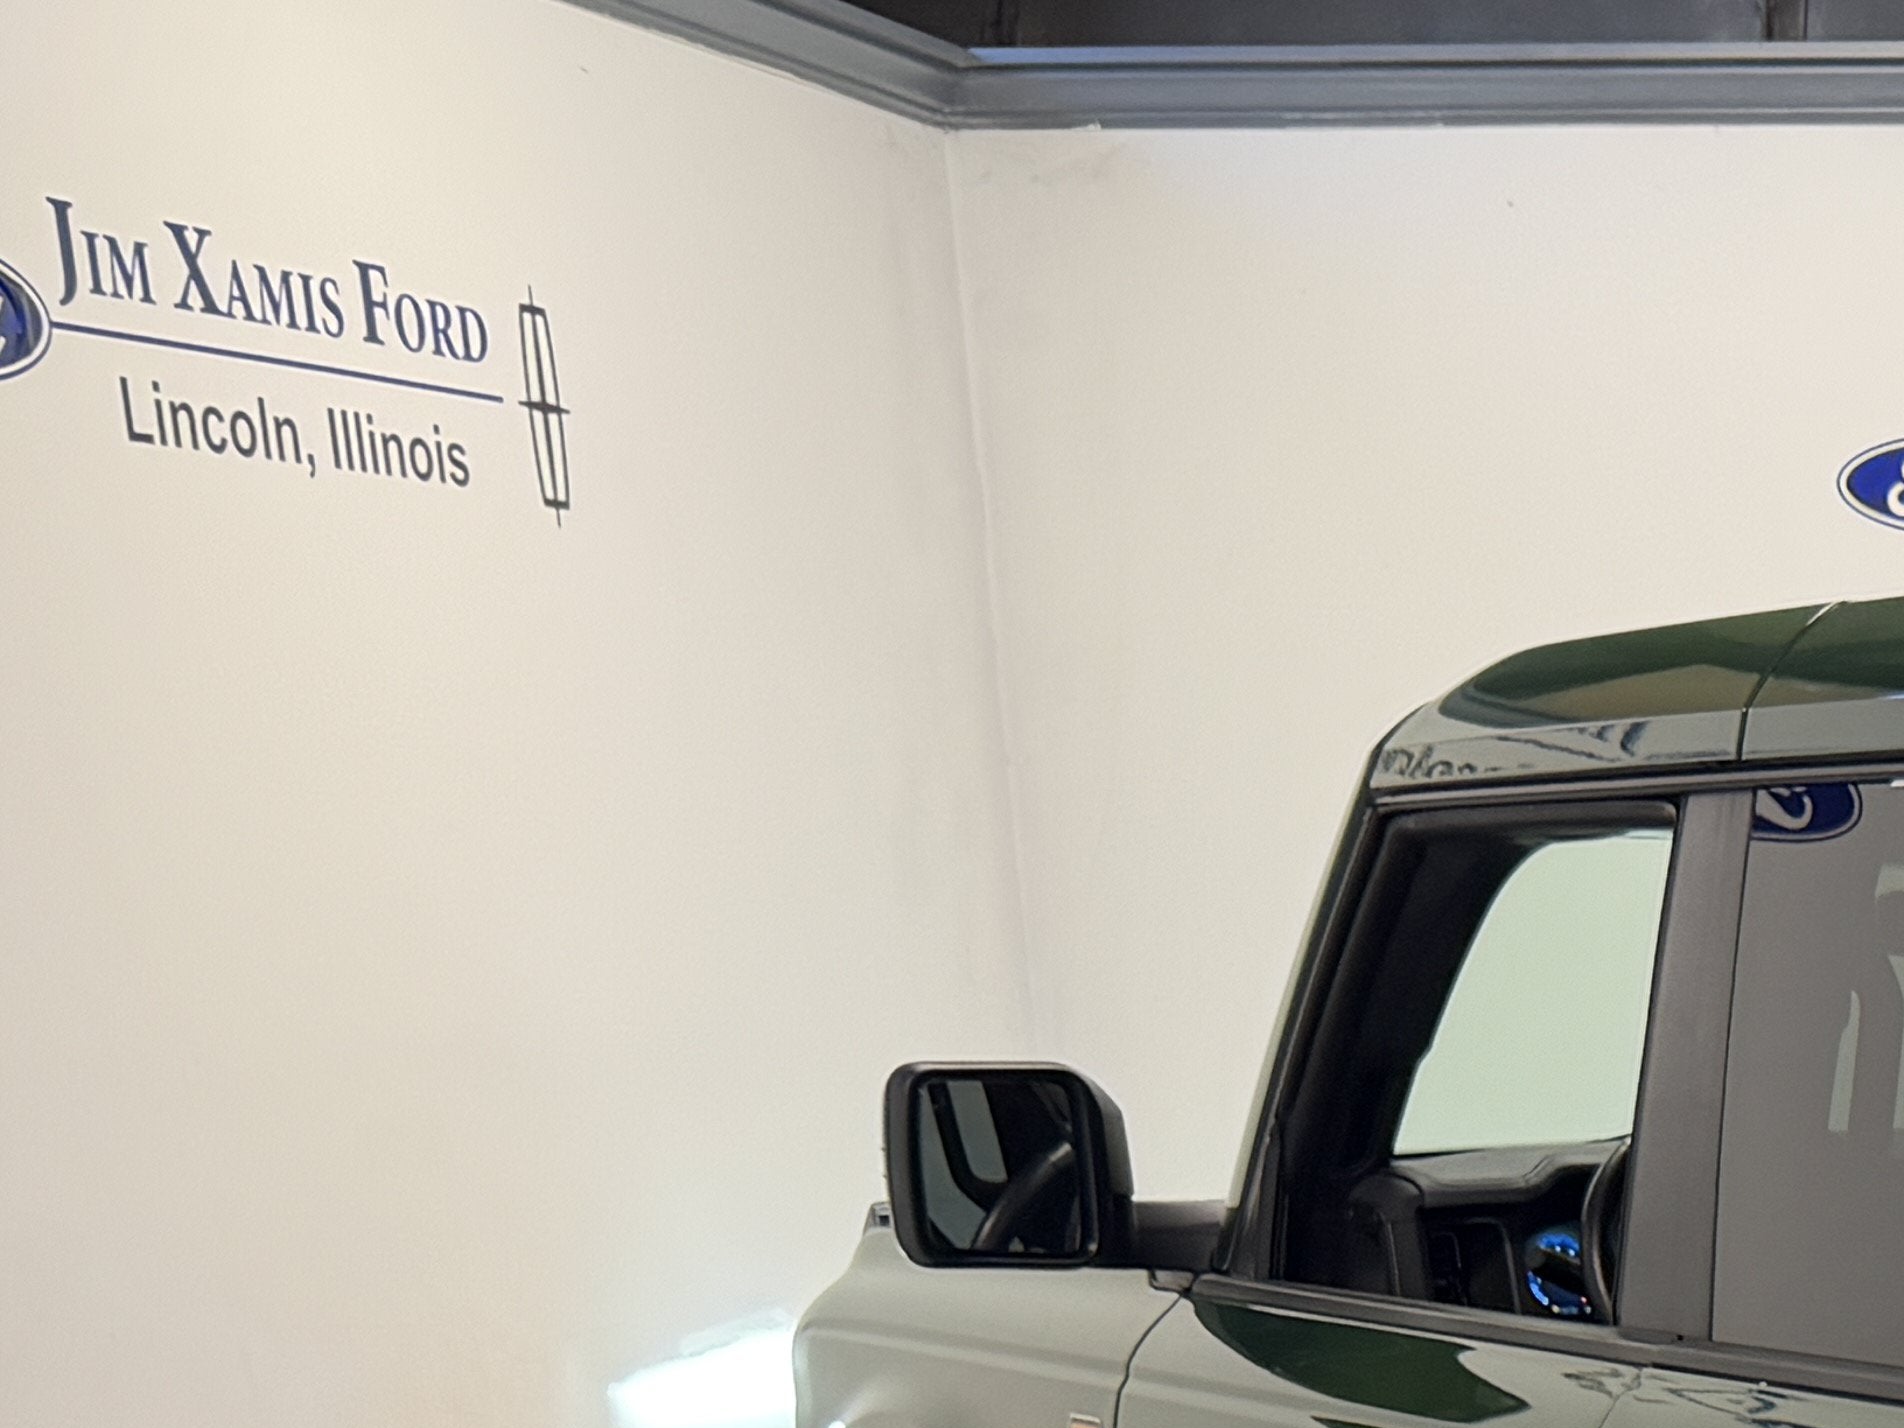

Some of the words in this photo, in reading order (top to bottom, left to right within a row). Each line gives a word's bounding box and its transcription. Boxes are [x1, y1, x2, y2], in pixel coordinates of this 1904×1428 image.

[163, 220, 346, 340] XAMIS
[352, 259, 489, 364] FORD
[118, 375, 317, 479] Lincoln,
[326, 406, 471, 487] Illinois
